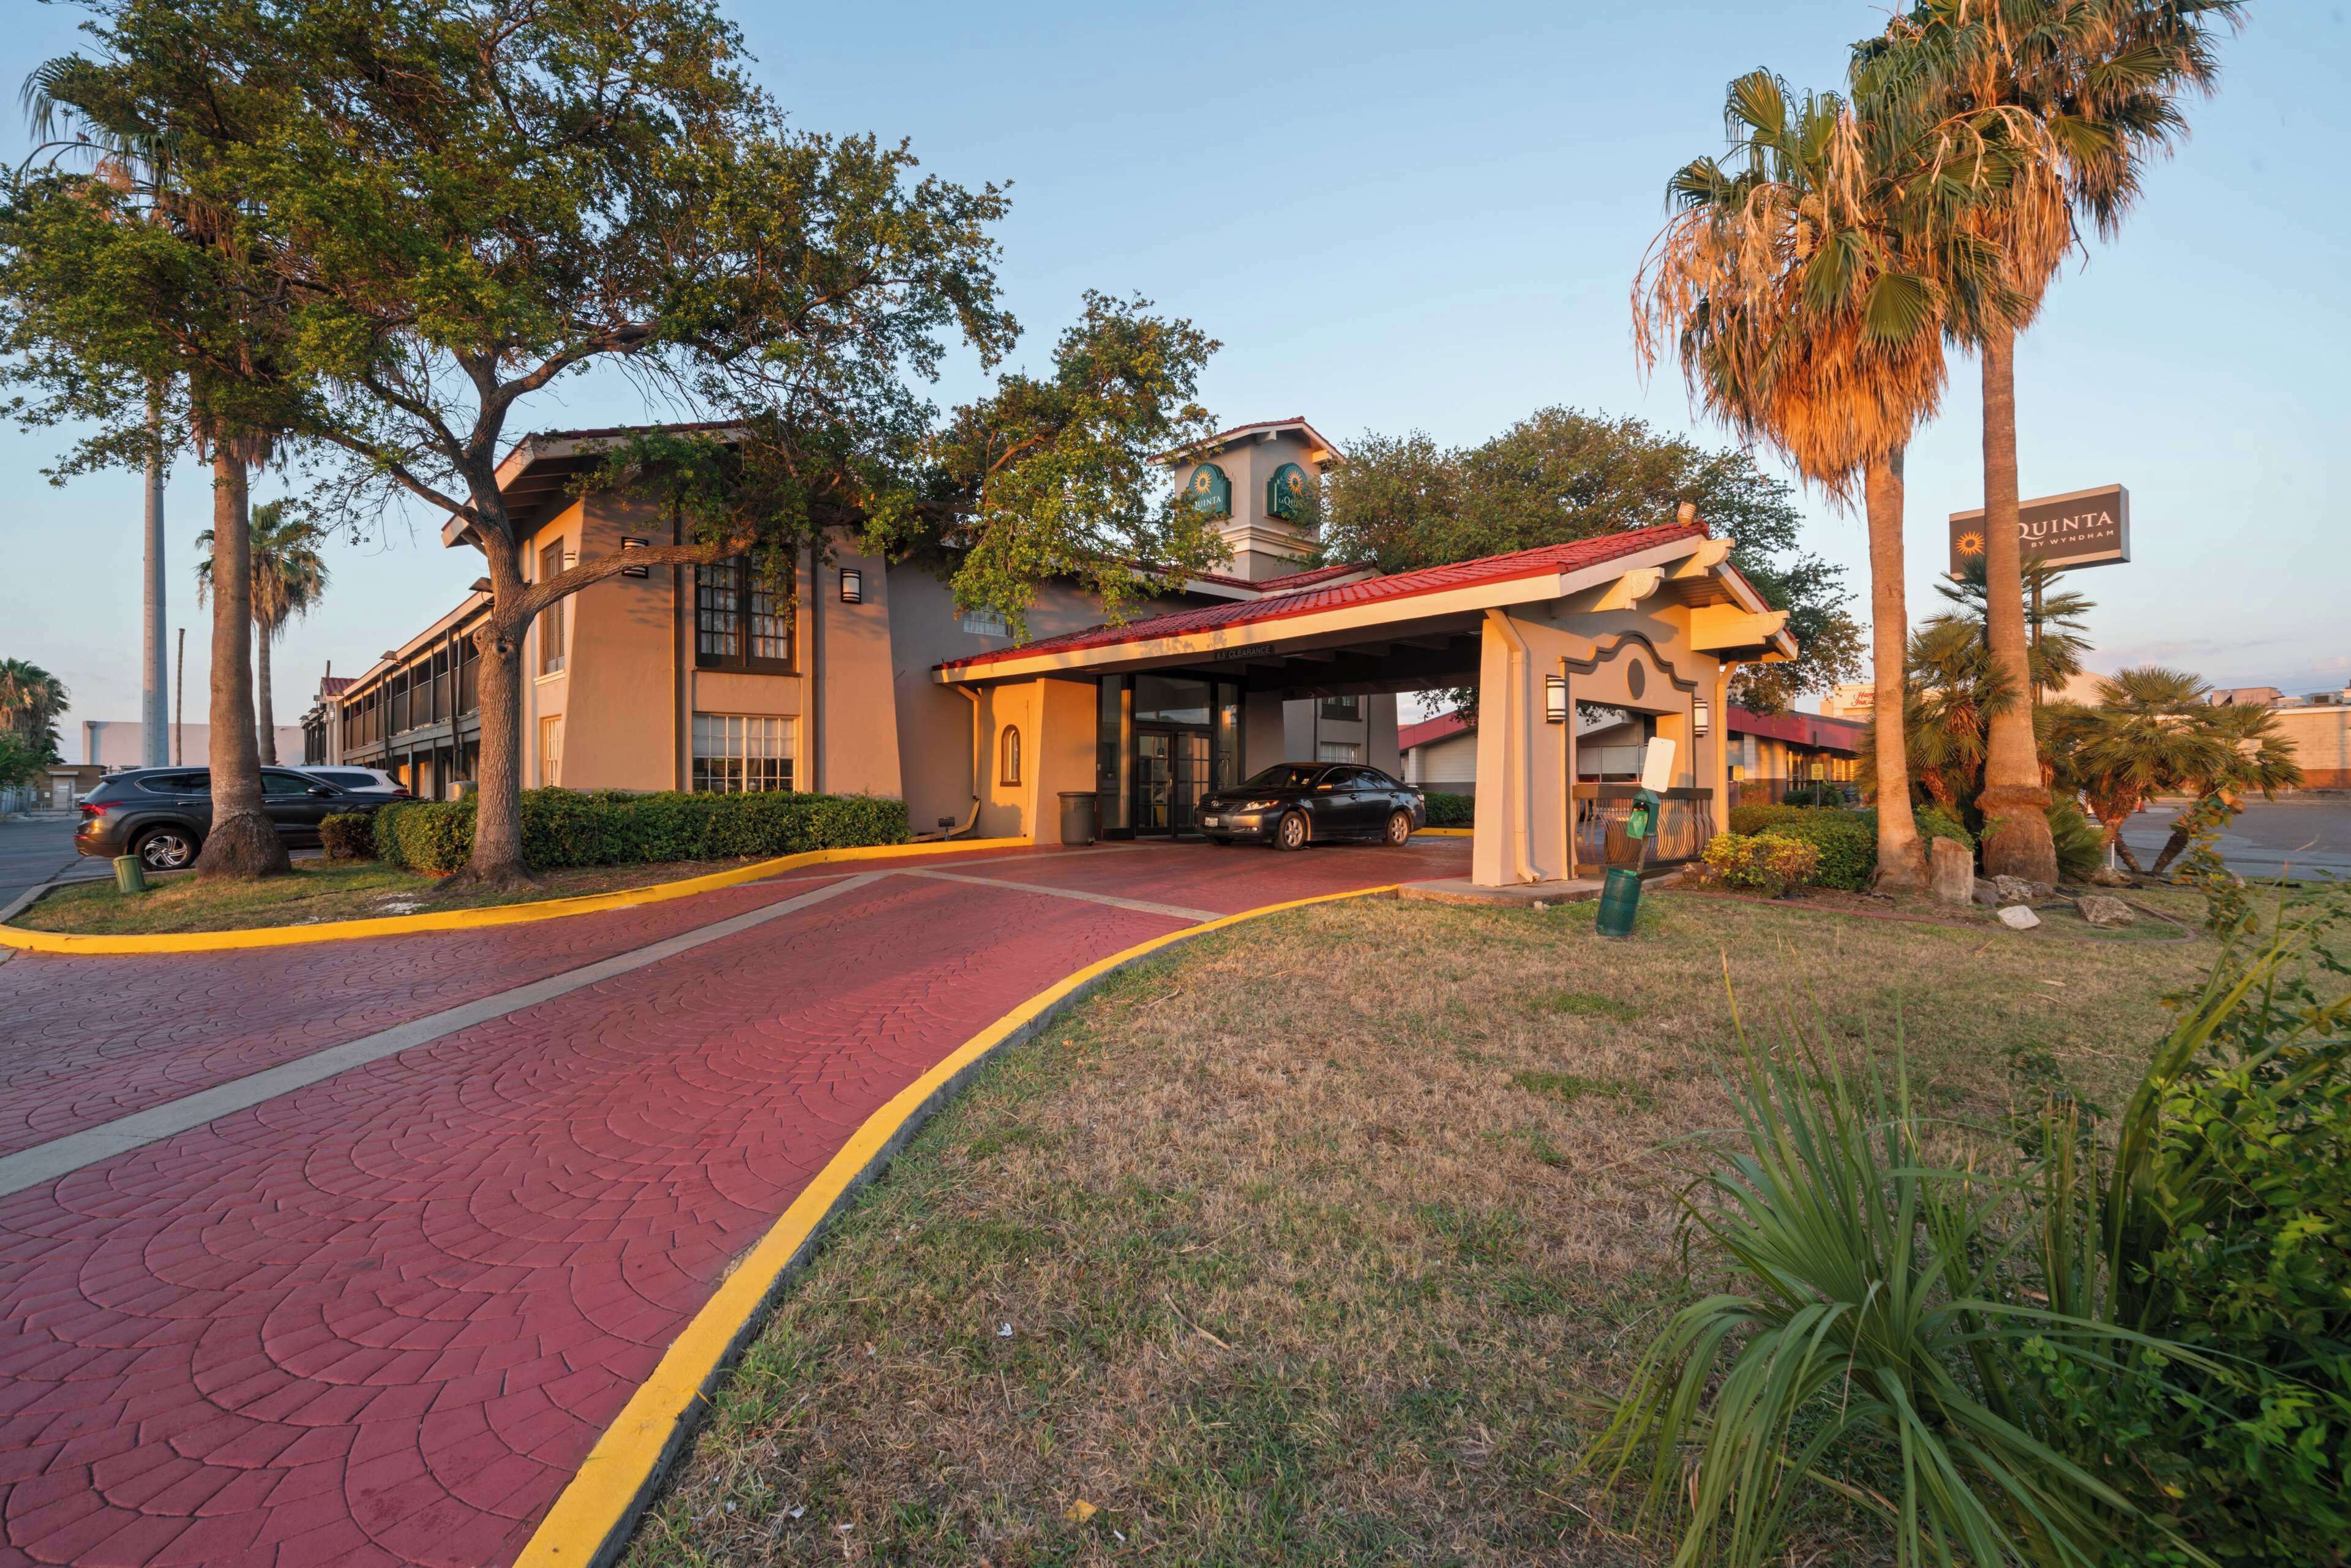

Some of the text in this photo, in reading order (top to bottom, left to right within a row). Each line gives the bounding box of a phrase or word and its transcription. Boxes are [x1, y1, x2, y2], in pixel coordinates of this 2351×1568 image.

[2019, 511, 2114, 540] QUINTA
[2050, 530, 2114, 544] WYNDHAM
[1228, 646, 1270, 658] CLEARANCE
